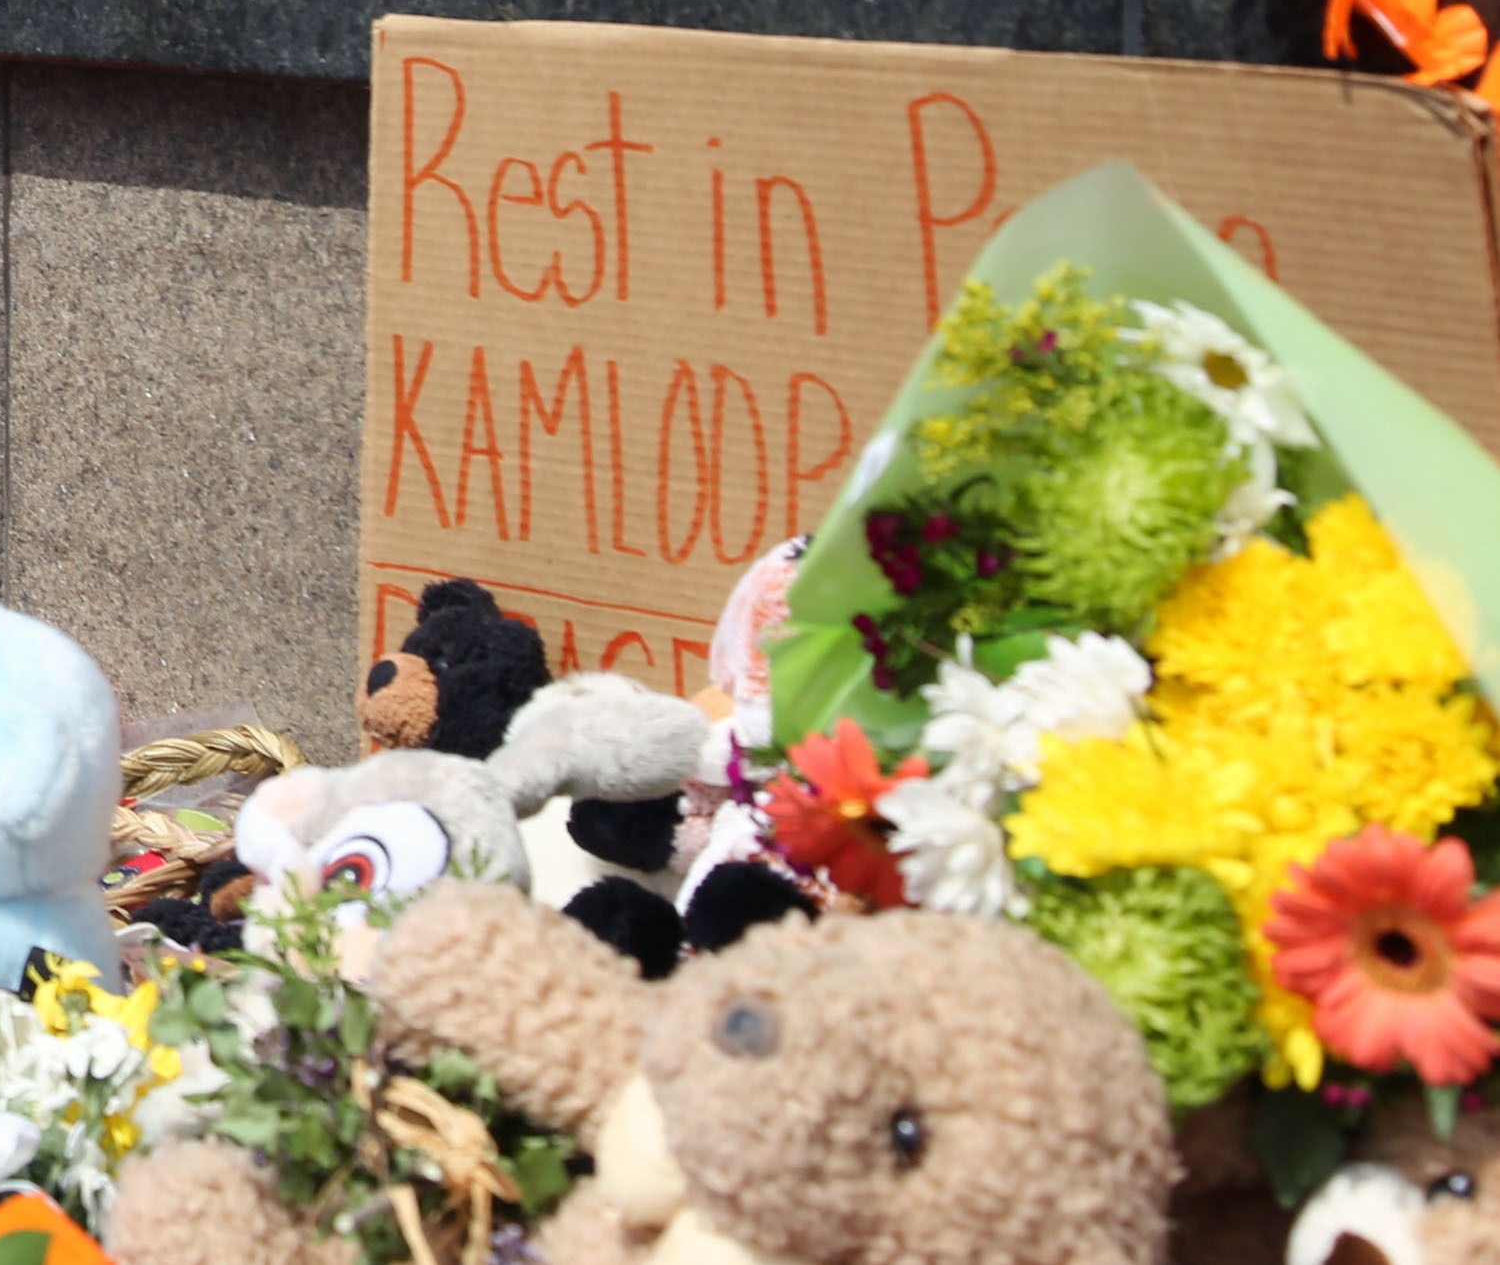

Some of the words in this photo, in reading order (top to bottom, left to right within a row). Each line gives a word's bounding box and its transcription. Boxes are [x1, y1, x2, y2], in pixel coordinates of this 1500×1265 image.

[402, 57, 654, 308] Rest
[706, 136, 828, 335] in
[384, 334, 853, 565] KAMLOOP
